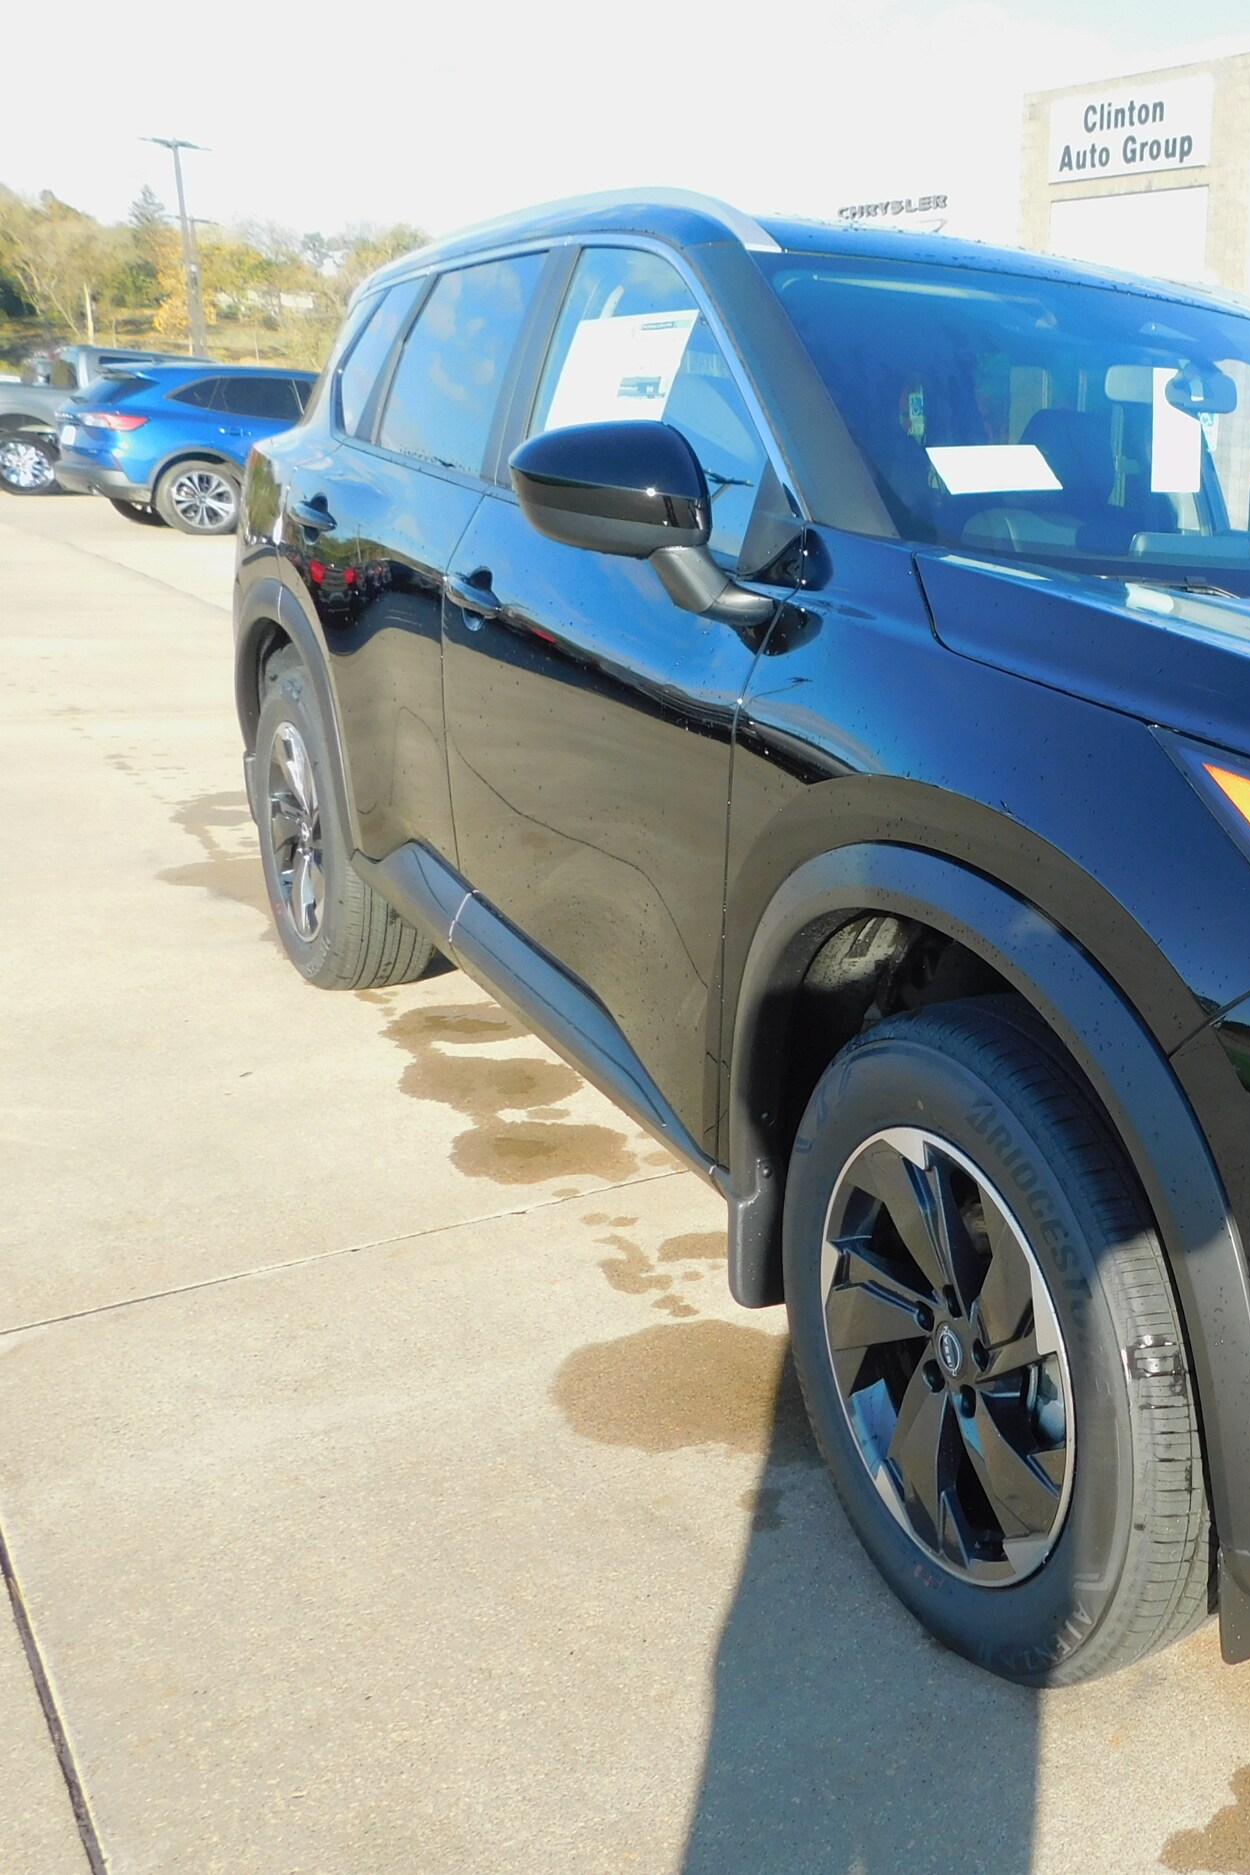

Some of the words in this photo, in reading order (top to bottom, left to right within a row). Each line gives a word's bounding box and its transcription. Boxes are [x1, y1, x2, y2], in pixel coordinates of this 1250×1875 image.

[1083, 100, 1165, 134] Clinton
[1059, 143, 1111, 172] Auto
[1122, 135, 1193, 164] Group
[837, 194, 948, 220] CHRYSLER
